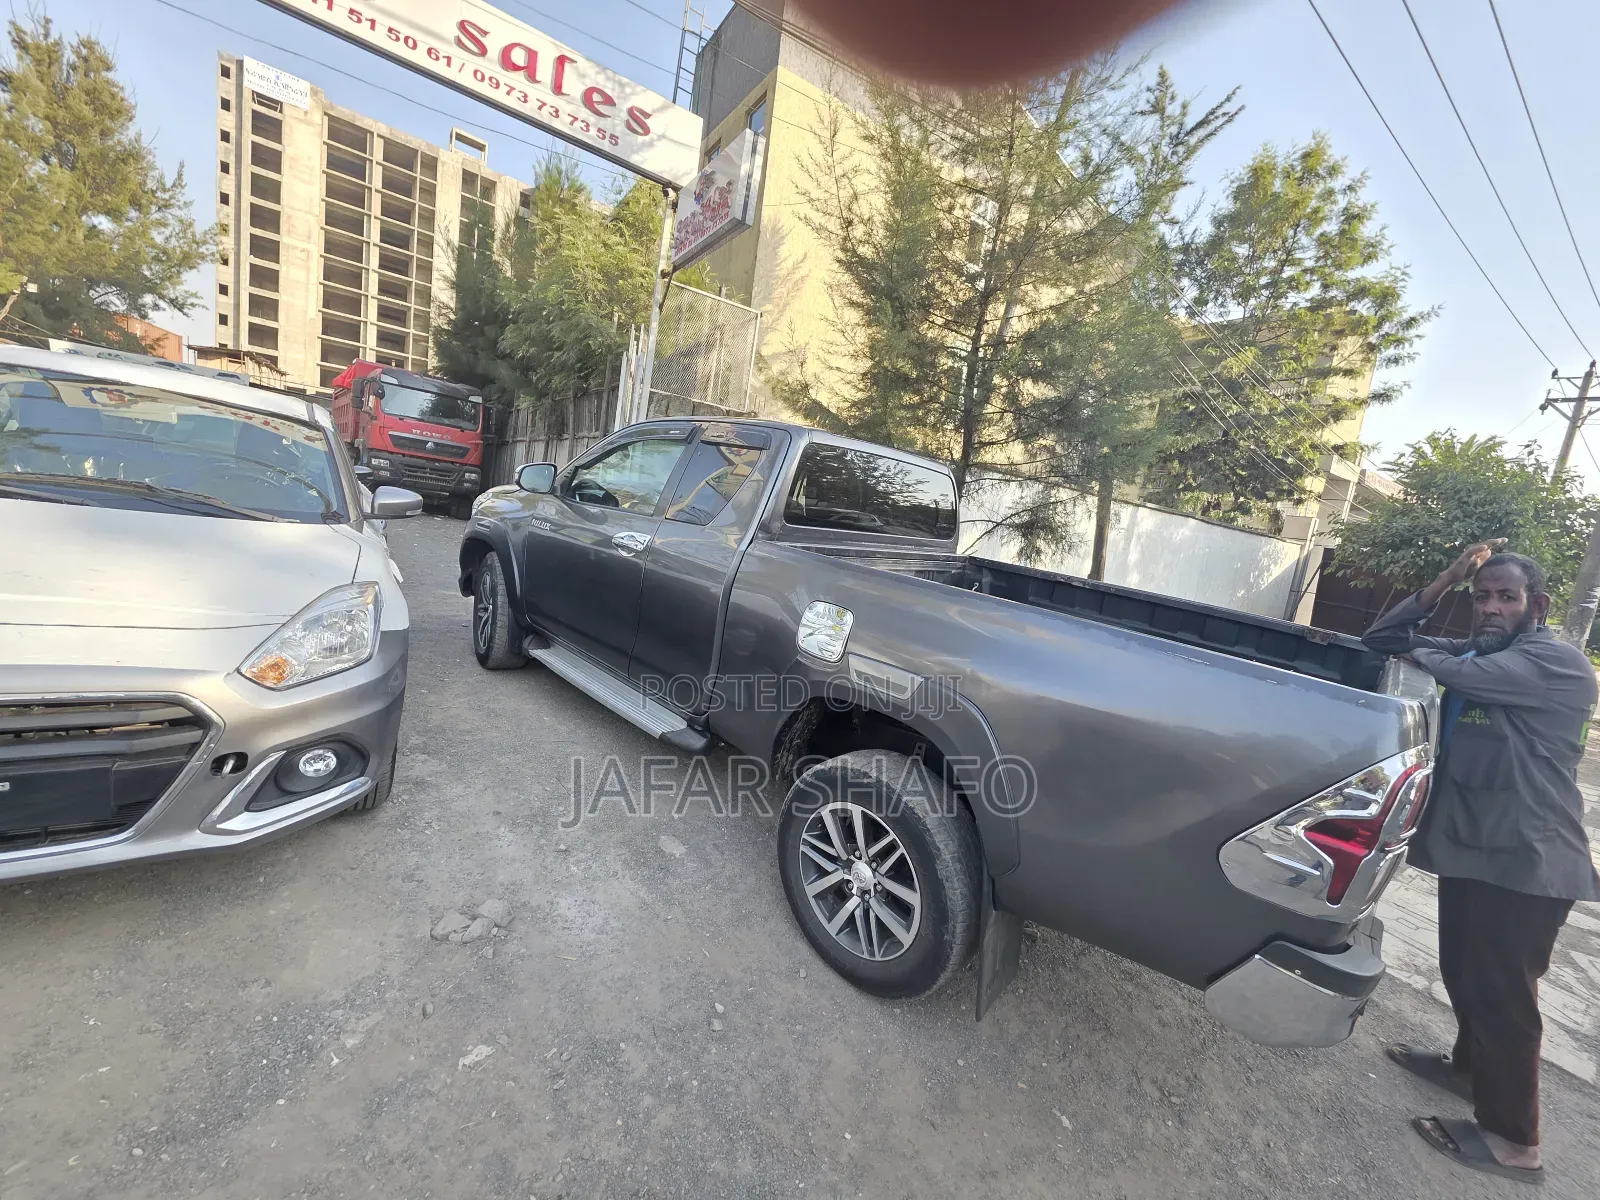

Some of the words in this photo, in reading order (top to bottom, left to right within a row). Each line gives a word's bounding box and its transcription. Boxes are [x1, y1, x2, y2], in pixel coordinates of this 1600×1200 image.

[347, 7, 377, 32] 51
[386, 26, 418, 51] 50
[473, 68, 529, 104] 0973
[536, 98, 560, 119] 73
[567, 113, 591, 133] 73
[595, 128, 620, 147] 55
[455, 19, 654, 137] sales
[531, 518, 552, 531] HILUX
